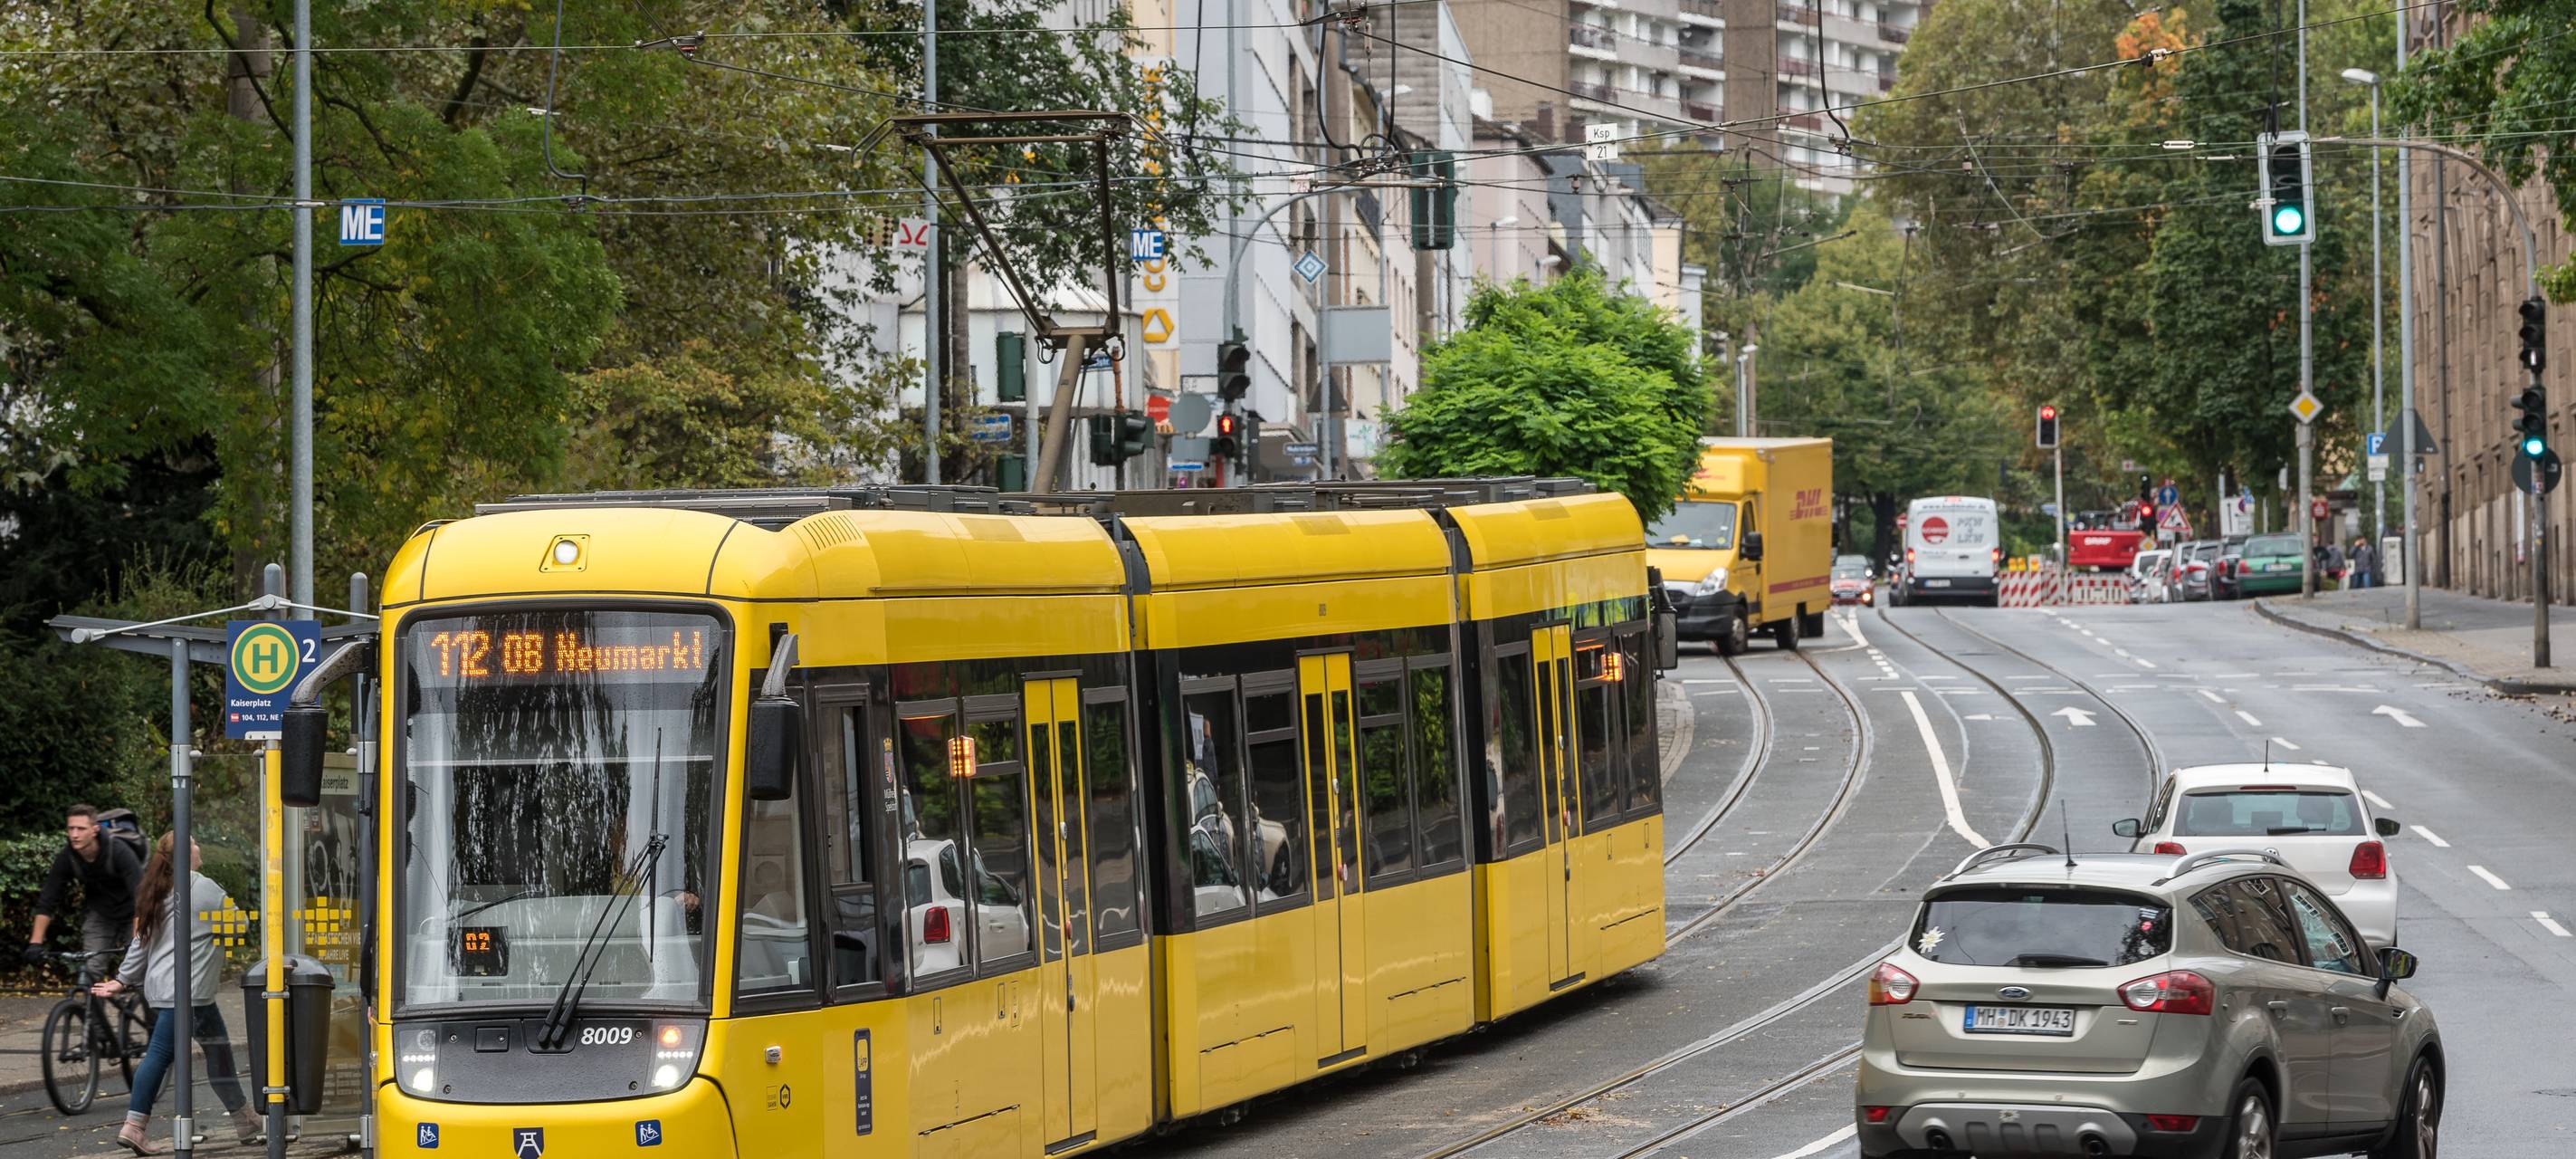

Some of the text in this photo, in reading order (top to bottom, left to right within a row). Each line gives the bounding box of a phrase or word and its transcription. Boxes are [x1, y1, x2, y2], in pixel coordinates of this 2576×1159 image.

[1593, 128, 1610, 139] Ksp
[1597, 146, 1608, 158] 21
[342, 205, 383, 240] ME
[1132, 232, 1162, 257] ME
[1795, 489, 1822, 519] DHL
[252, 643, 278, 674] H
[301, 638, 316, 663] 2
[431, 631, 489, 675] 112
[556, 631, 701, 671] Neumarkt
[230, 699, 272, 709] Kaiserplatz
[242, 714, 255, 722] 104,
[256, 714, 269, 722] 112,
[322, 774, 348, 792] aiserplatz
[465, 933, 490, 951] 02
[1976, 1008, 2071, 1029] MH DK 1943
[580, 1027, 633, 1045] 8009
